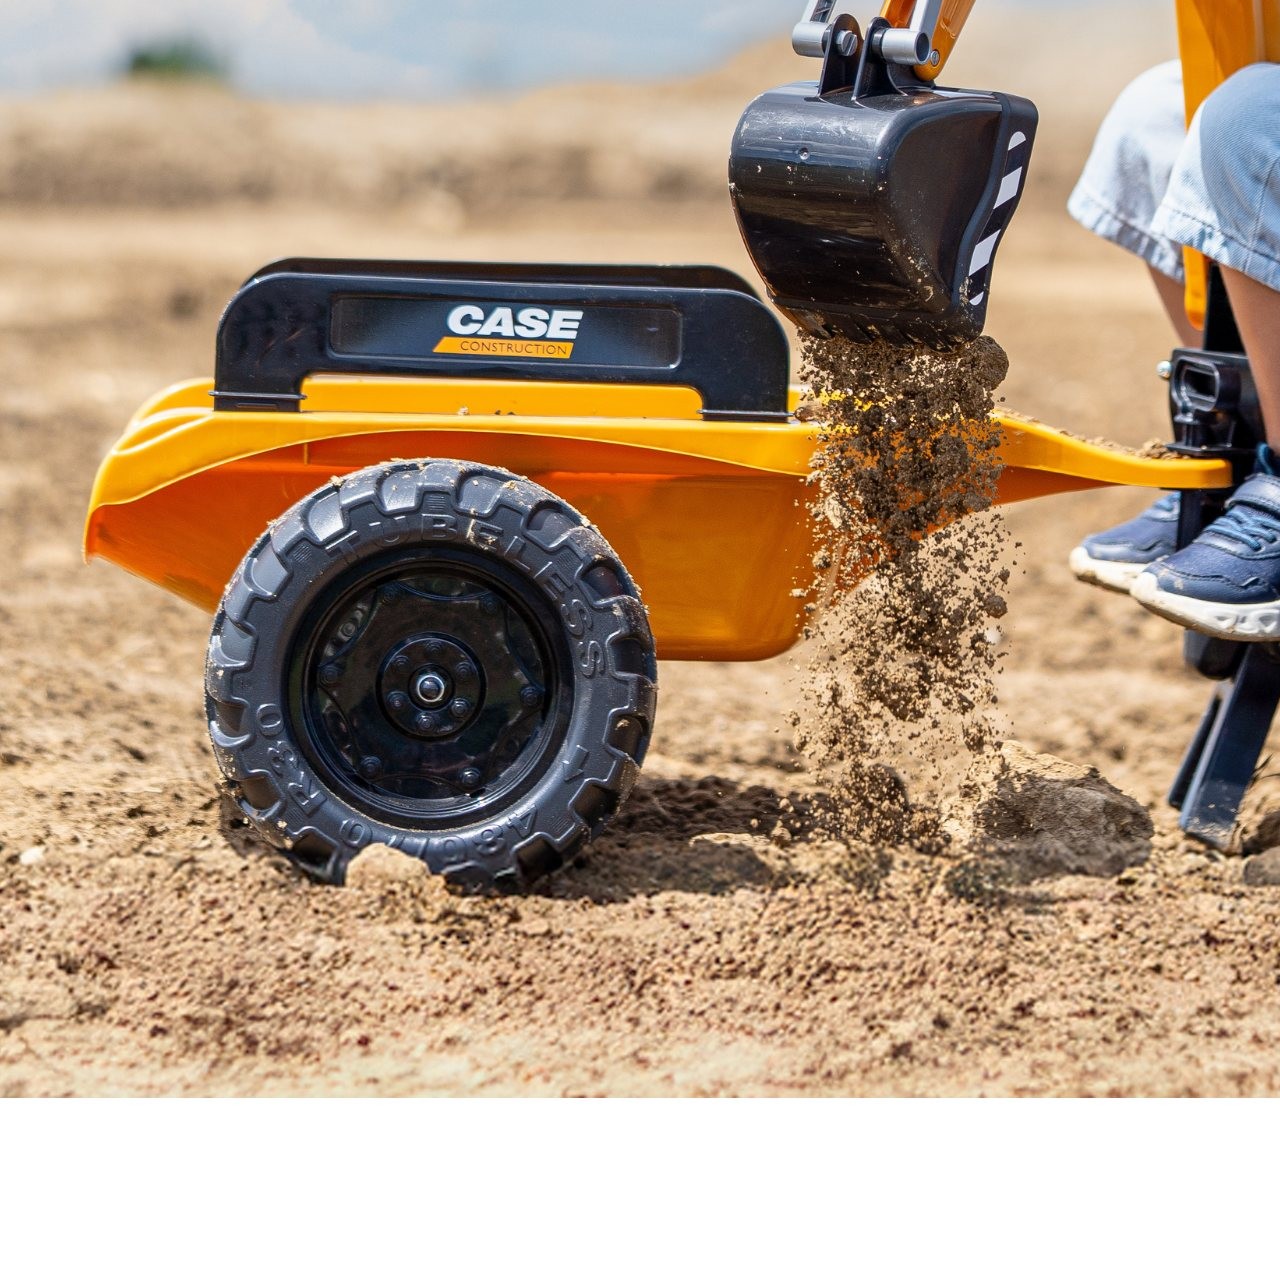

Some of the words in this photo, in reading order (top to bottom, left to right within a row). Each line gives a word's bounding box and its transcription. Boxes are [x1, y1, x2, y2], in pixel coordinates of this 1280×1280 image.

[447, 305, 583, 339] CASE
[460, 340, 567, 356] CONSTRUCTION
[324, 512, 605, 678] TUBELESS
[255, 703, 329, 819] R30
